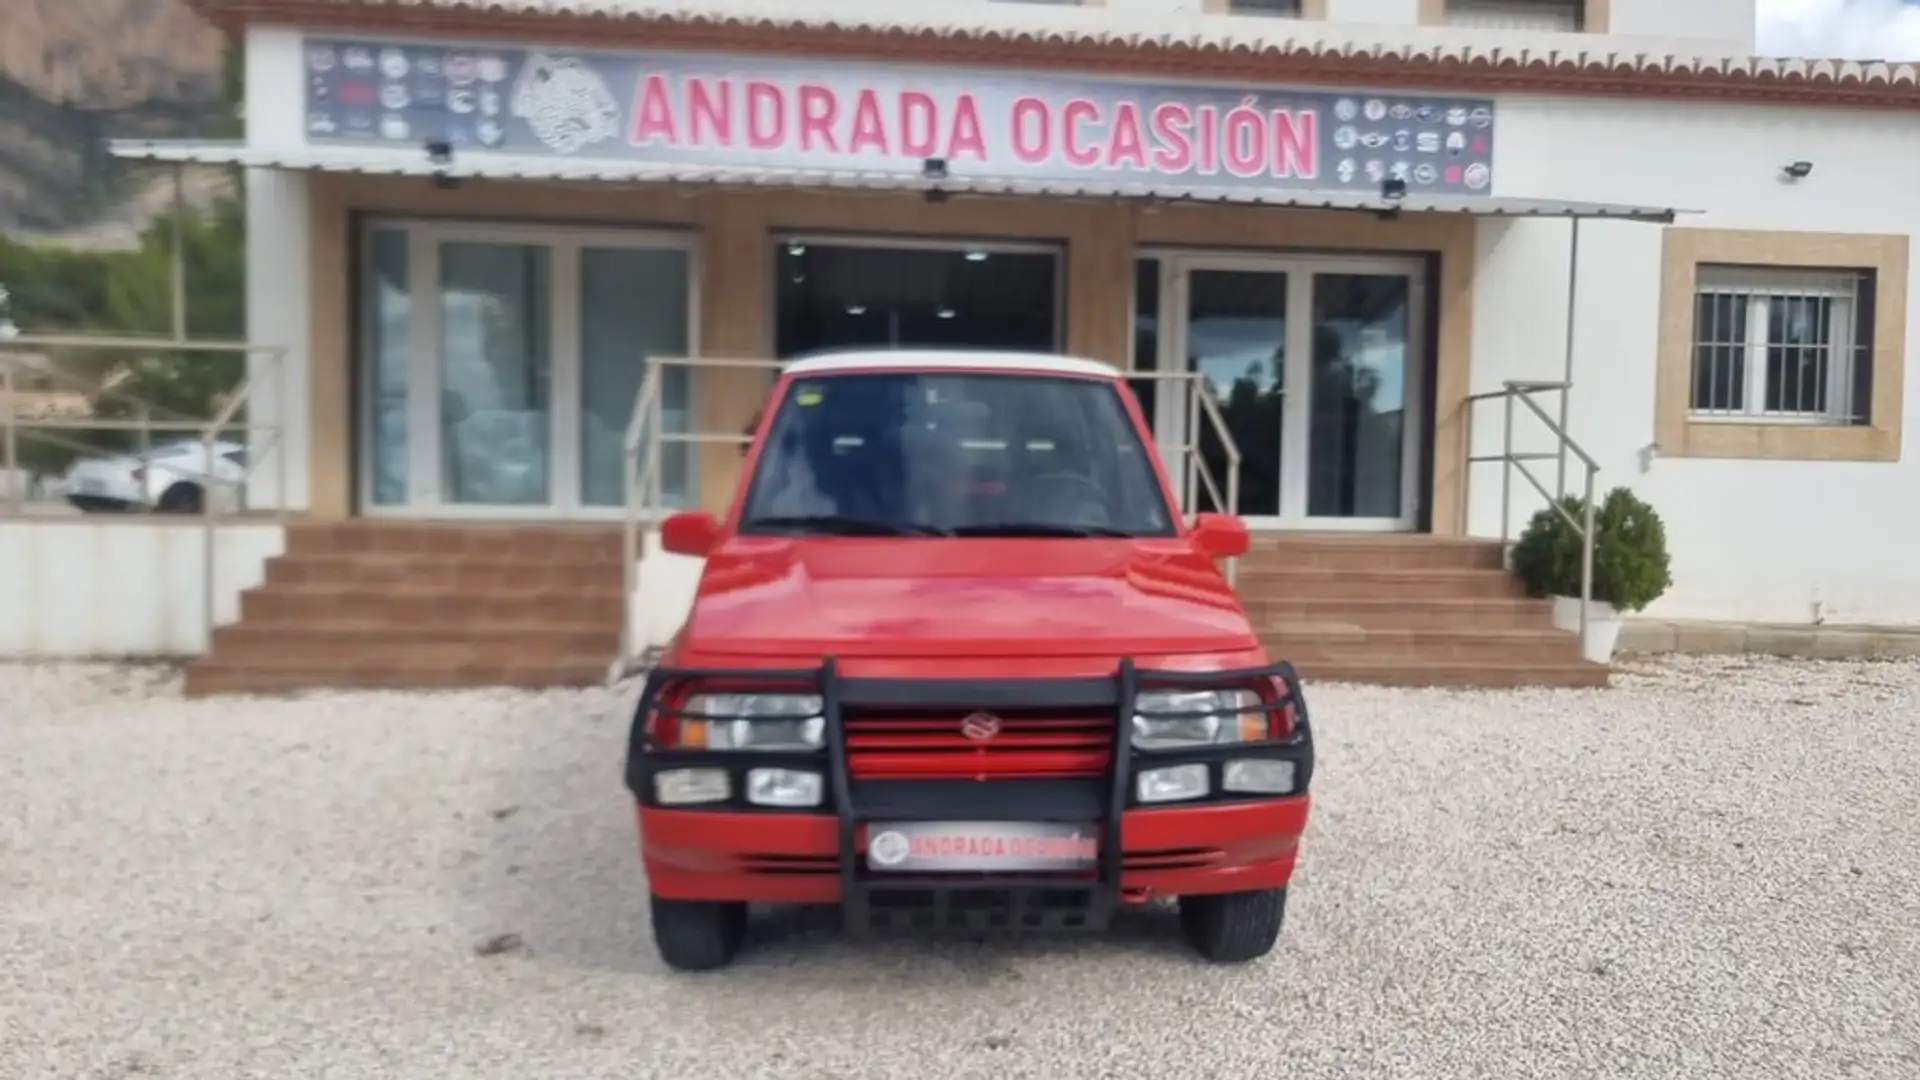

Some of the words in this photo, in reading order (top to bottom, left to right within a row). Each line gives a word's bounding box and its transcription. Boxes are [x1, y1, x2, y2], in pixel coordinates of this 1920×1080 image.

[632, 74, 987, 161] ANDRADA
[1010, 95, 1319, 178] OCASIÓN
[911, 835, 1005, 858] ANDRADA
